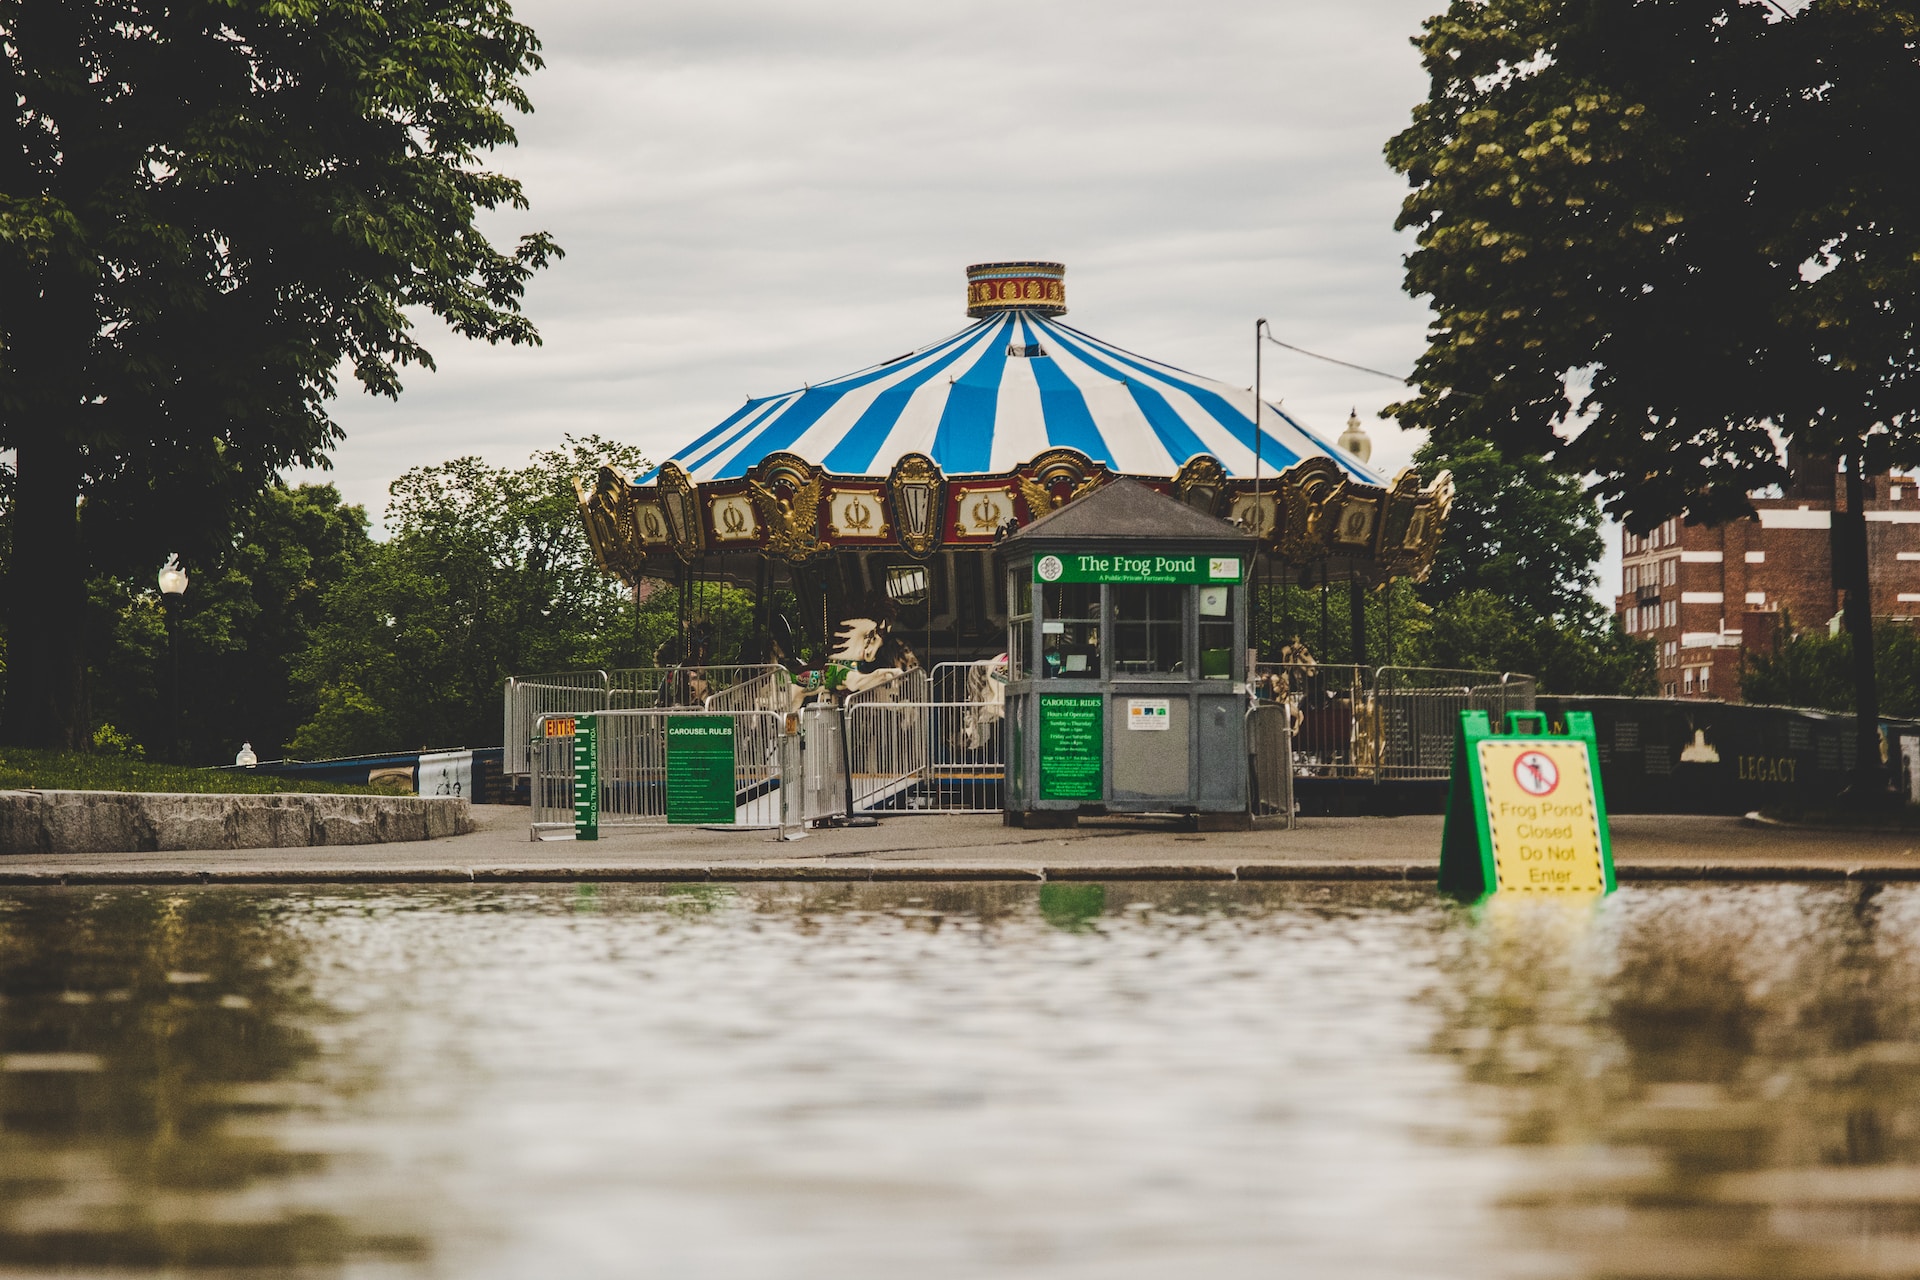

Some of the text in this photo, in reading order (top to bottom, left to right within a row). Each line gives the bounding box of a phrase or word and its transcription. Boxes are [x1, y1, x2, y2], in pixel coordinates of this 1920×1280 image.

[1078, 556, 1196, 575] The Frog Pond
[1143, 575, 1177, 583] Partnership
[1041, 699, 1101, 707] CAROUSEL RIDES
[669, 728, 732, 736] CAROUSEL RULES
[590, 761, 597, 770] BE
[1738, 755, 1797, 783] LEGACY
[590, 801, 597, 811] TO
[1500, 802, 1584, 820] Frog Pond
[1517, 824, 1573, 839] Closed
[1520, 846, 1577, 861] Do Not
[1529, 868, 1572, 883] Enter
